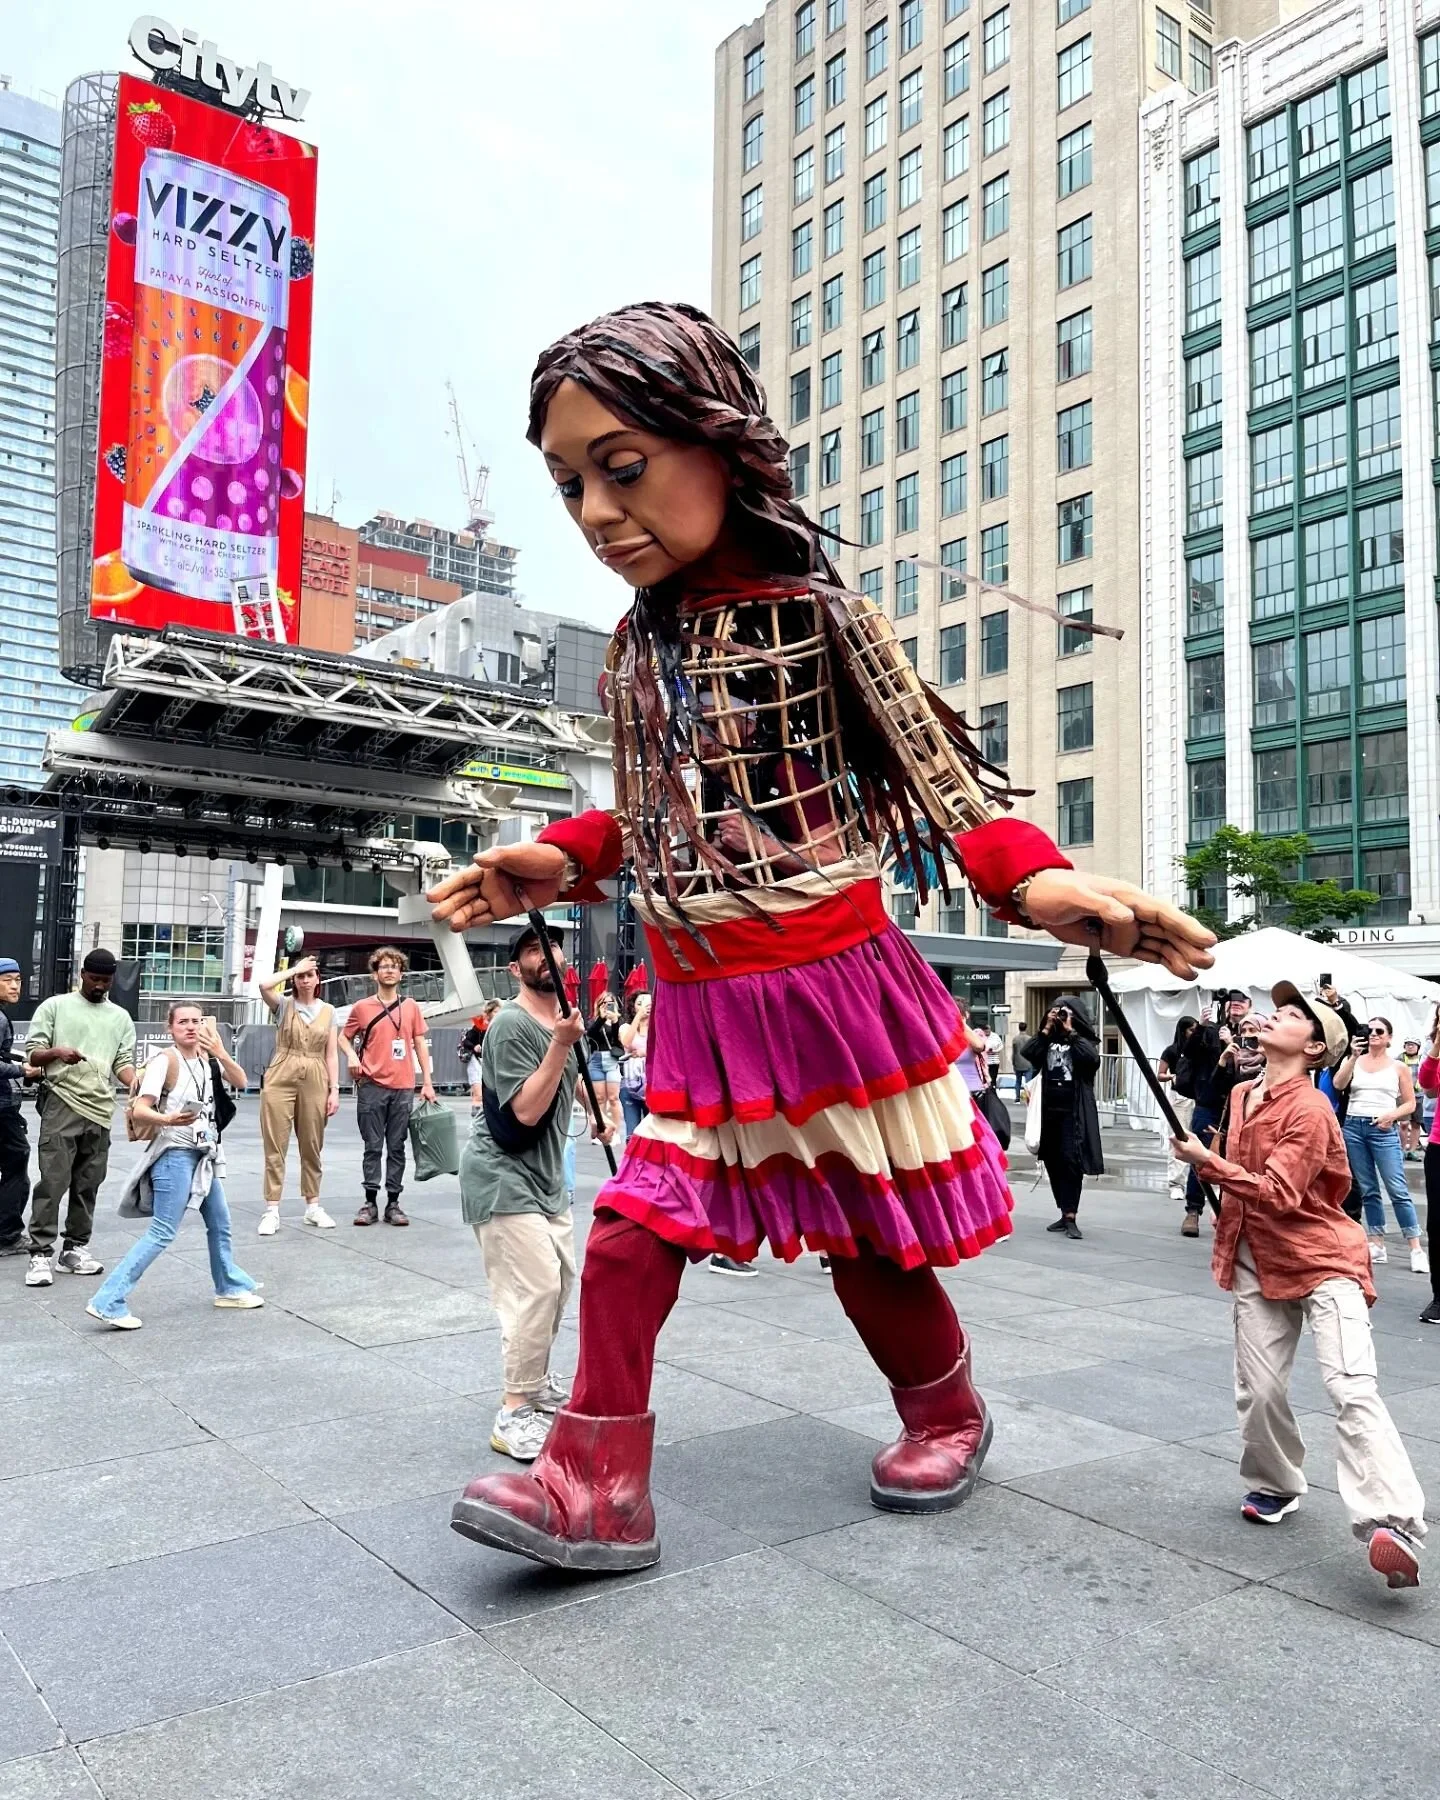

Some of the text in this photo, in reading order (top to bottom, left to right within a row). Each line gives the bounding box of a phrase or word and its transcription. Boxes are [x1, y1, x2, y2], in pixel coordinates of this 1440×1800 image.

[128, 15, 312, 120] Citytv
[145, 177, 287, 263] VIZZY
[152, 228, 197, 251] HARD
[149, 267, 275, 314] PAPAYA PASSIONFRUIT
[137, 520, 267, 556] SPARKLING HARD SELTZER
[159, 537, 246, 561] WITH ACEROLA CHERRY
[302, 555, 350, 579] PLACE
[302, 573, 350, 597] HOTEL
[0, 816, 57, 829] E-DUNDAS
[1337, 928, 1395, 944] LDING
